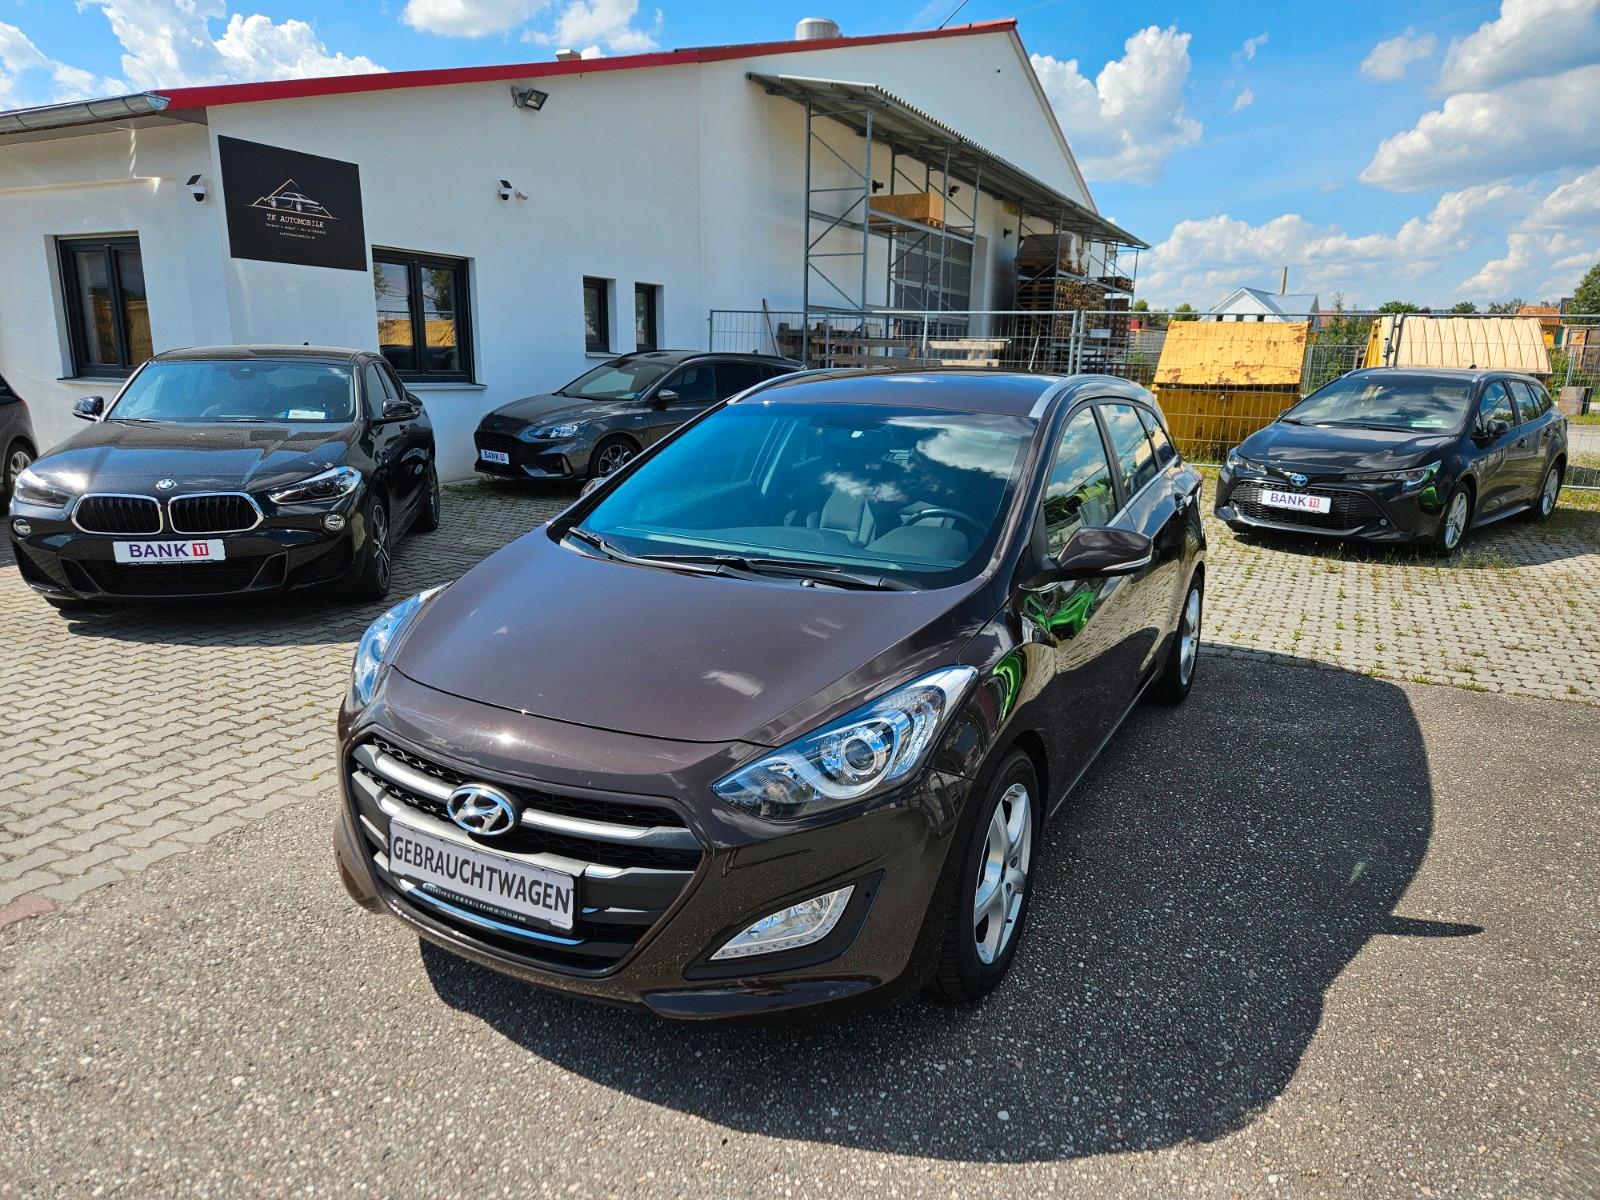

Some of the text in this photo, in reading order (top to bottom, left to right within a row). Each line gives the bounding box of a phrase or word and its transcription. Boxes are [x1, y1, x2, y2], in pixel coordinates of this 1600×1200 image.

[280, 215, 324, 228] AUTOMOBILE
[1270, 492, 1306, 506] BANK
[128, 543, 208, 558] BANK 11
[393, 835, 571, 914] GEBRAUCHTWAGEN
